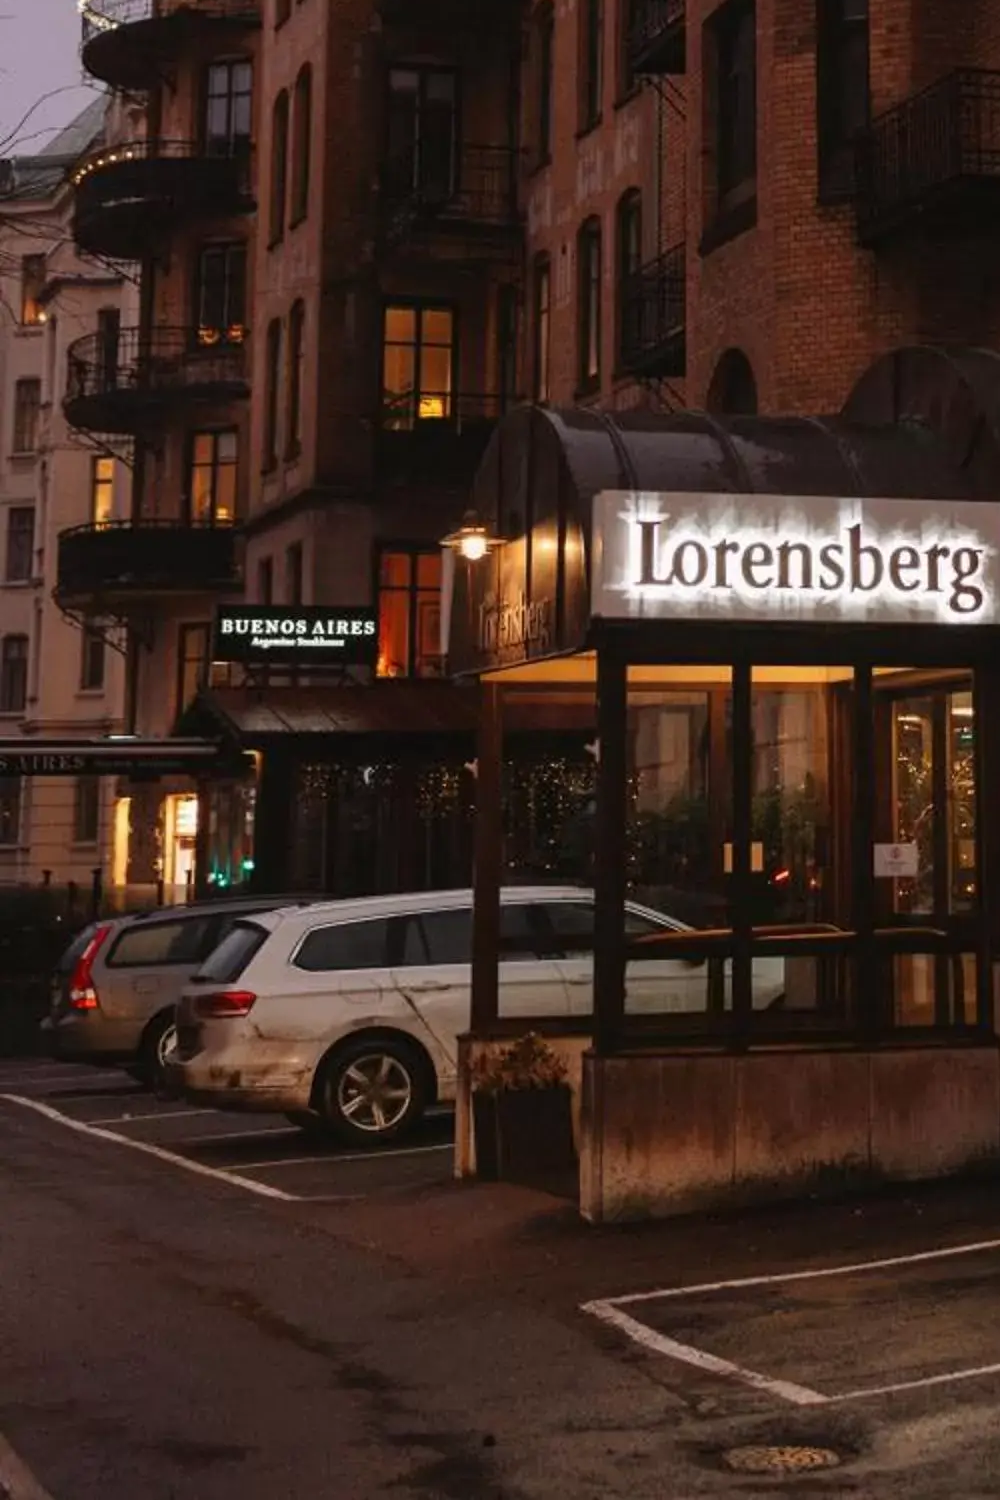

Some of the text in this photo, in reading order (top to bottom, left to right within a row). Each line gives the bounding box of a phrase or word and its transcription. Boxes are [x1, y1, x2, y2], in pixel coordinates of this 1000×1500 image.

[634, 520, 984, 614] Lorensberg
[221, 618, 375, 635] BUENOS AIRES
